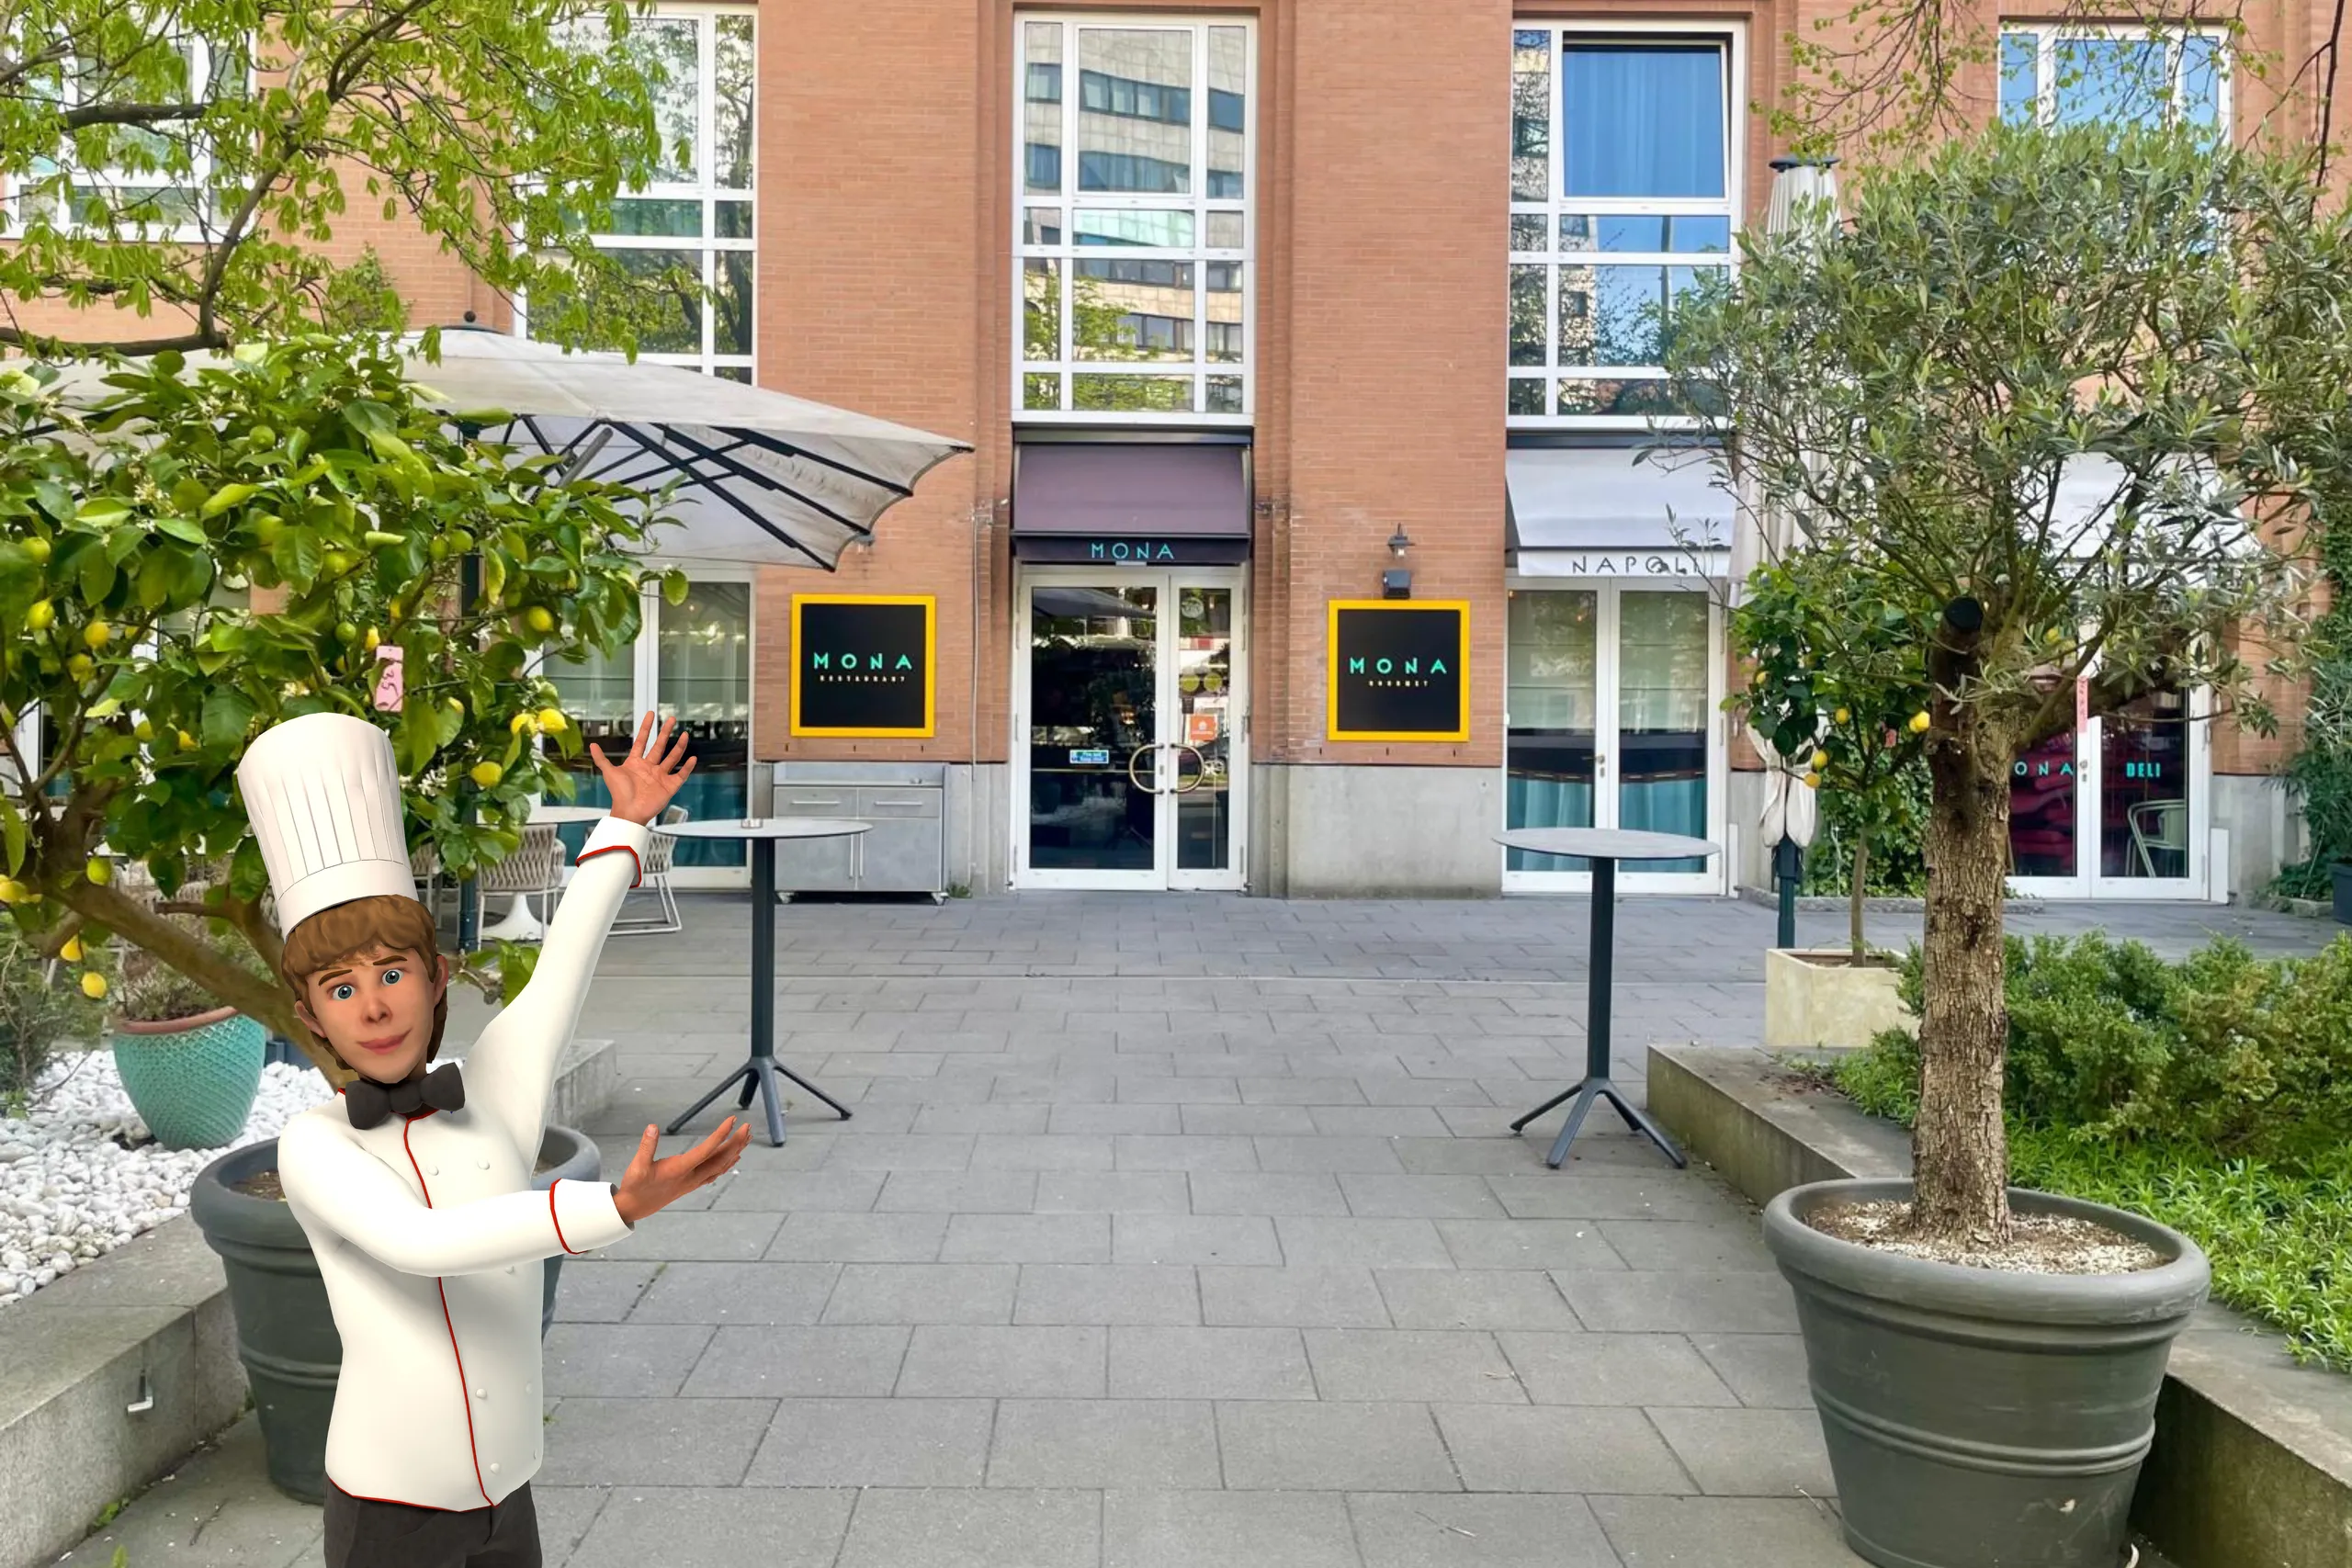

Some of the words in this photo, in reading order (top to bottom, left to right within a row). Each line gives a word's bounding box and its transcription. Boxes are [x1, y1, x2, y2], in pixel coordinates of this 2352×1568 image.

[1091, 541, 1174, 559] MONA
[1572, 555, 1698, 574] NAPOLI
[813, 652, 912, 670] MONA
[1349, 657, 1447, 674] MONA
[2014, 761, 2074, 776] ONA
[2125, 762, 2161, 777] DELI
